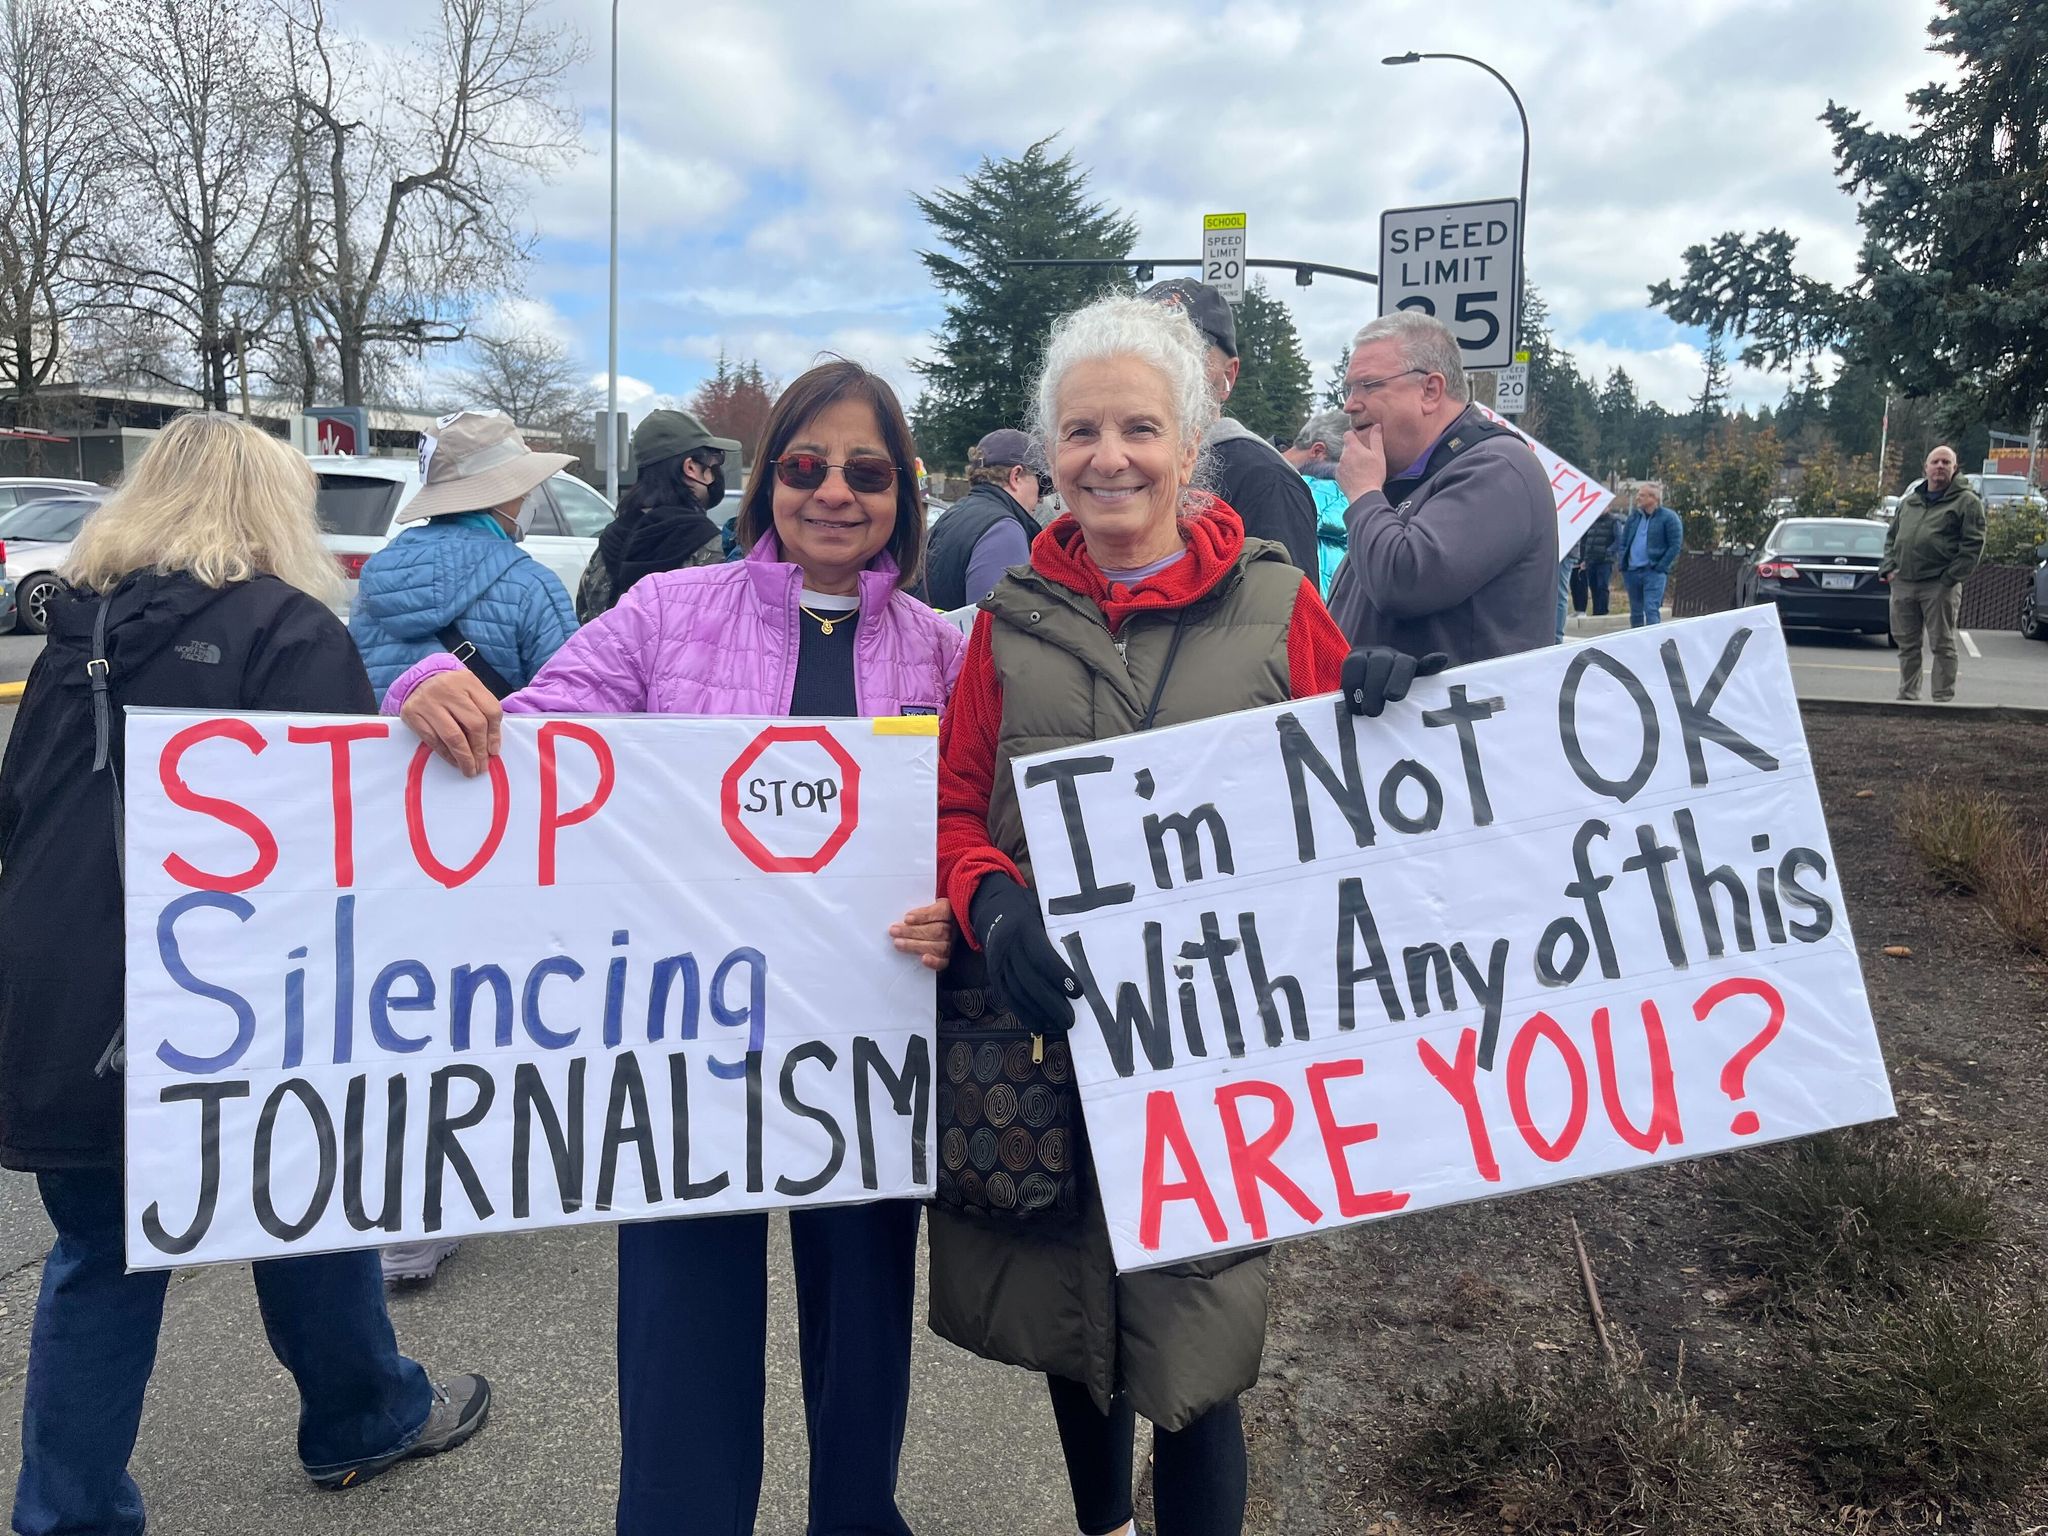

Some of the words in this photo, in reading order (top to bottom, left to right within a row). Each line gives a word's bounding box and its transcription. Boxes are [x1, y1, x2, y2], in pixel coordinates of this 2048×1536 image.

[1207, 217, 1243, 228] SCHOOL
[1390, 219, 1508, 255] SPEED
[1207, 236, 1242, 247] SPEED
[1210, 248, 1238, 258] LIMIT
[1208, 260, 1239, 280] 20
[1402, 255, 1493, 287] LIMIT
[1498, 382, 1524, 396] 20
[1025, 754, 1236, 916] I'm
[1275, 684, 1507, 863] Not
[1558, 627, 1780, 803] OK
[158, 717, 616, 894] STOP
[744, 777, 838, 814] STOP
[154, 889, 768, 1079] Silencing
[1059, 911, 1310, 1078] With
[1337, 877, 1510, 1072] Any
[1138, 1058, 1411, 1251] ARE
[1417, 977, 1787, 1184] YOU?
[141, 1033, 929, 1255] JOURNALISM
